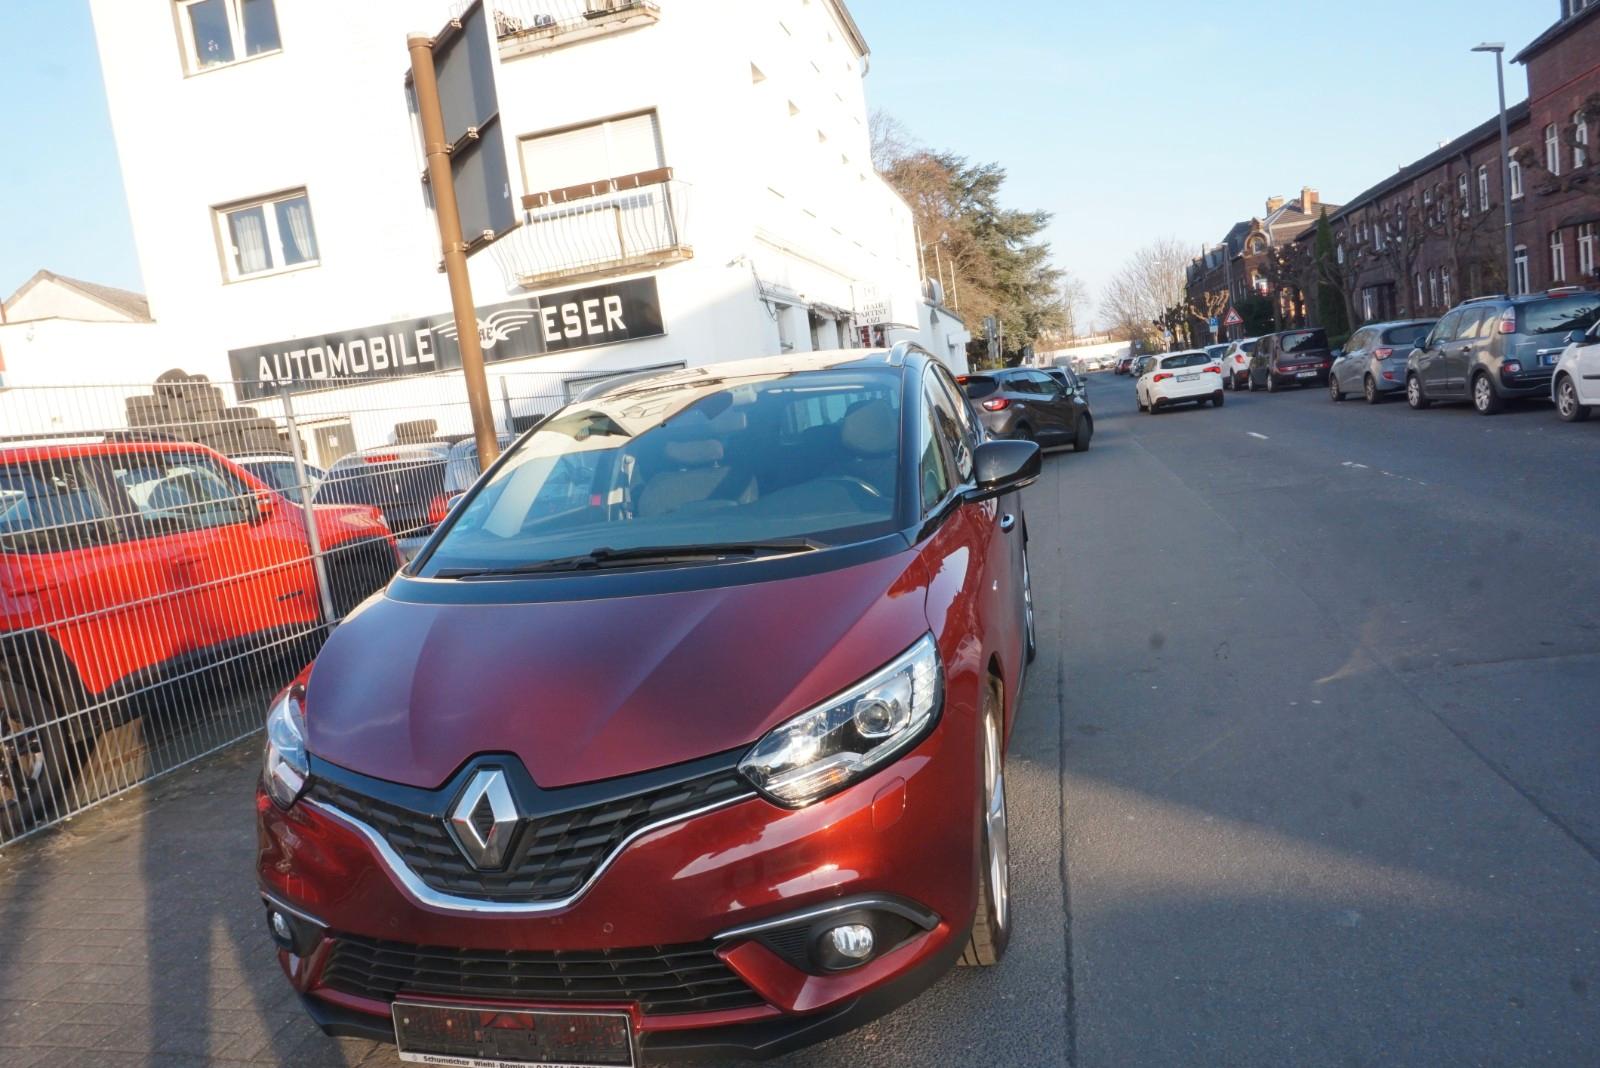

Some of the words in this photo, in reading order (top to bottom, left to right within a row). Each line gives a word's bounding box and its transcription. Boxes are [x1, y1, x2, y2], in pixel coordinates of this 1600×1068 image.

[258, 328, 435, 389] AUTOMOBILE
[541, 295, 627, 342] ESER
[423, 1055, 470, 1066] Schumacher
